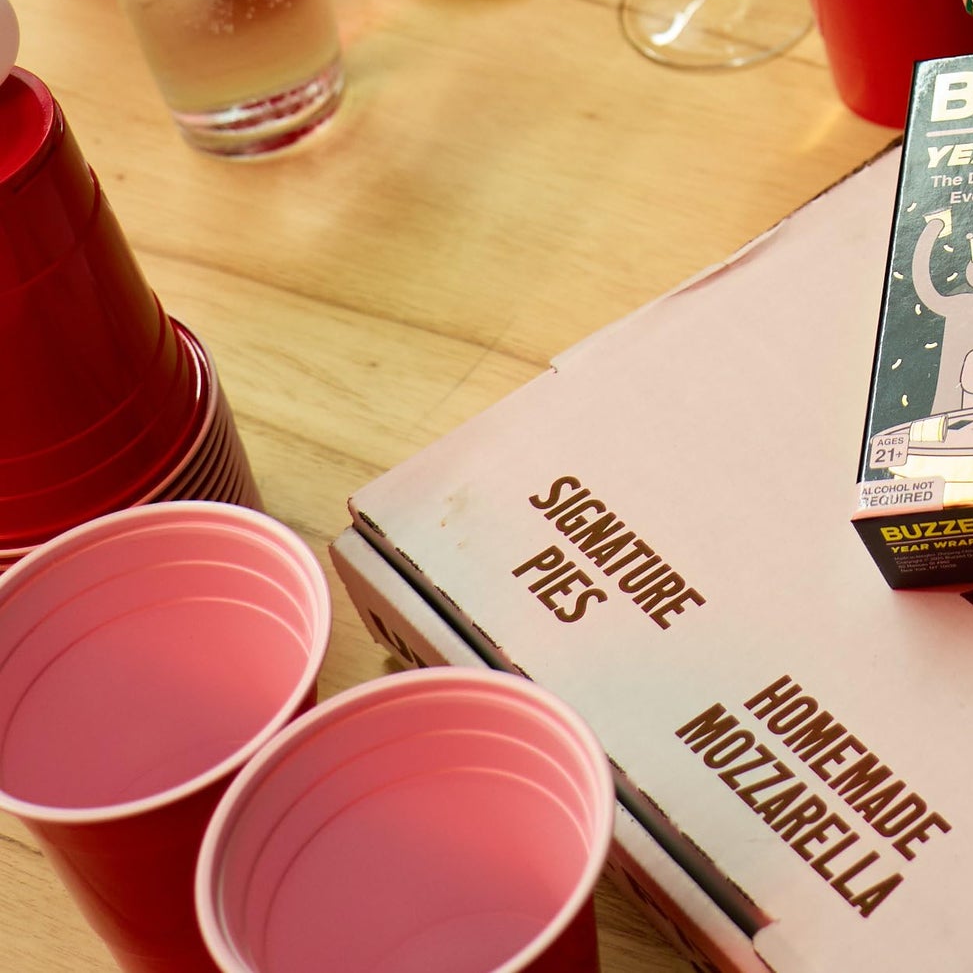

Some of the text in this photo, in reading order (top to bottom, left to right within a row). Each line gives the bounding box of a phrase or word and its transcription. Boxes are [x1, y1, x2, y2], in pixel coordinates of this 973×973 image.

[931, 175, 961, 188] The
[877, 437, 904, 446] AGES
[875, 448, 903, 464] 21+
[861, 481, 934, 495] ALCOHOL NOT
[529, 476, 707, 630] SIGNATURE
[891, 543, 929, 554] YEAR
[511, 545, 608, 623] PIES
[743, 674, 952, 861] HOMEMADE
[674, 702, 904, 919] MOZZARELLA
